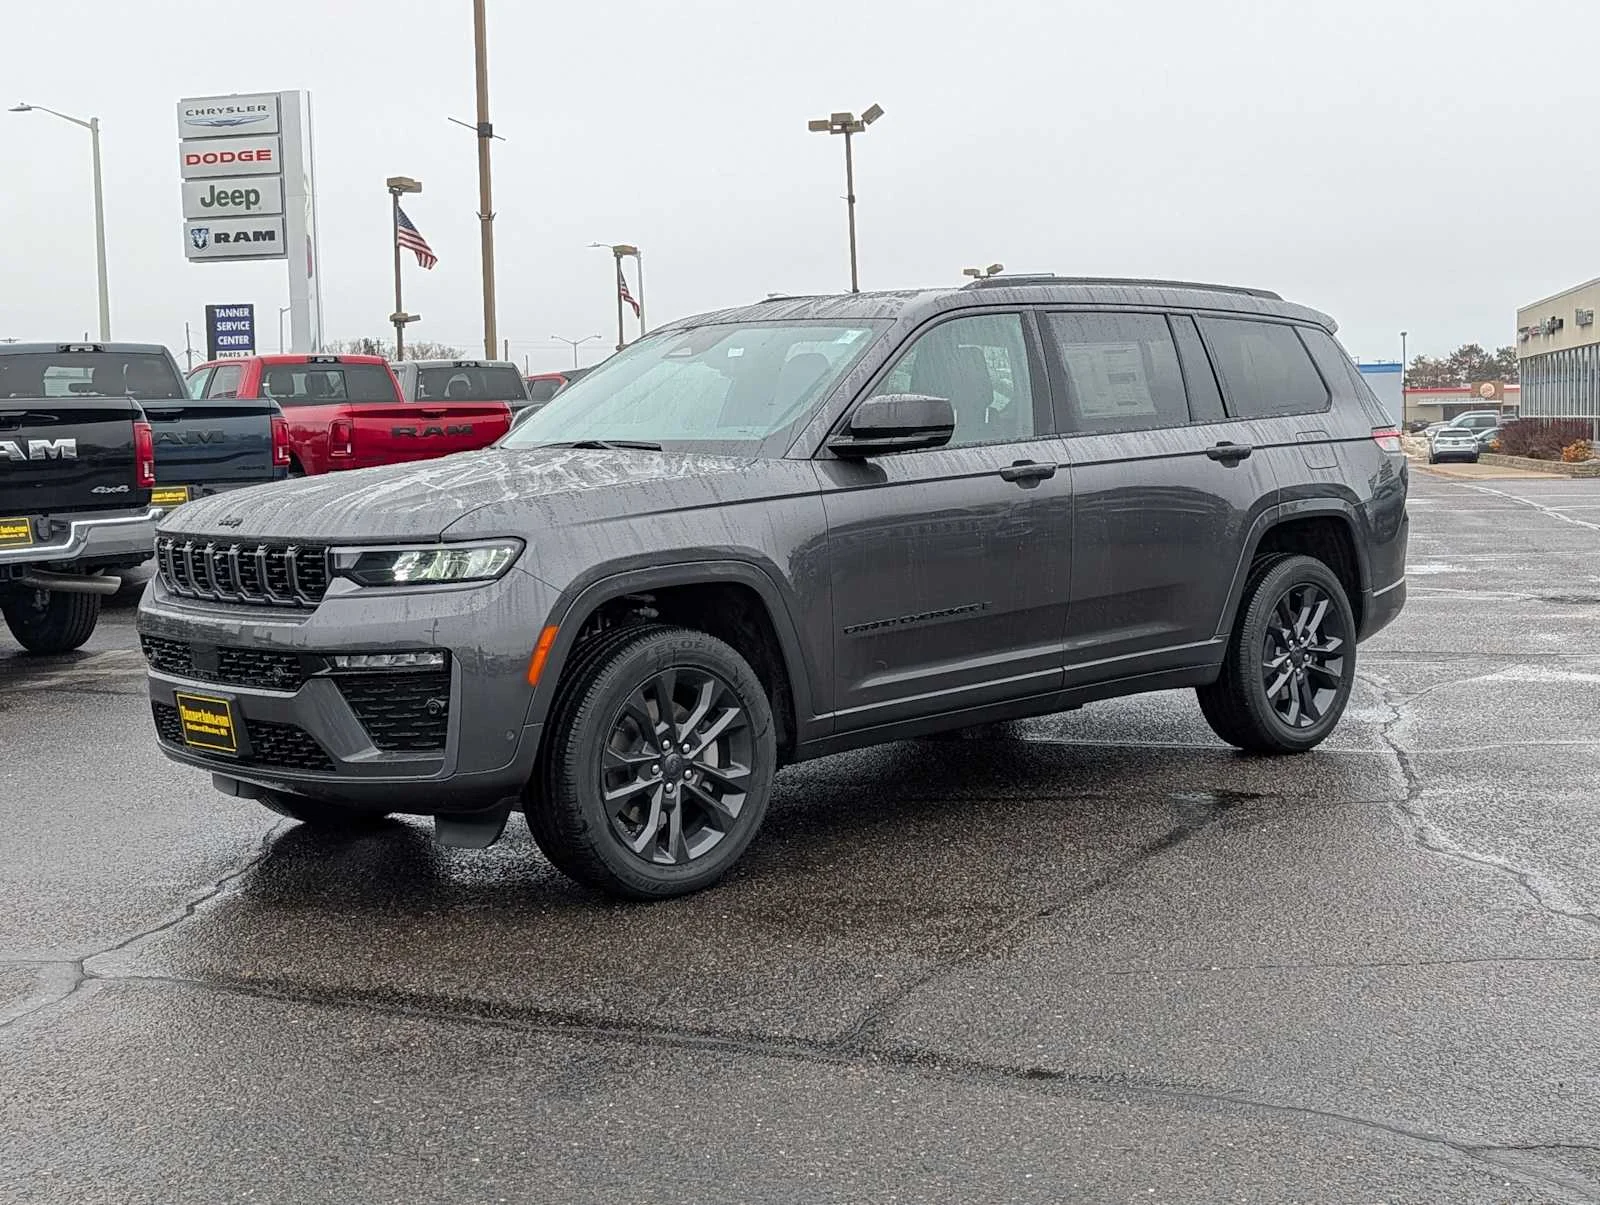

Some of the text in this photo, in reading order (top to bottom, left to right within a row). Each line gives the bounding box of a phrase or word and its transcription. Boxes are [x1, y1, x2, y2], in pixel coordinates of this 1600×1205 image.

[185, 105, 267, 116] CHRYSLER
[186, 149, 272, 166] DODGE
[200, 185, 260, 210] Jeep
[214, 230, 276, 244] RAM
[215, 308, 250, 318] TANNER
[216, 321, 251, 331] SERVICE
[217, 335, 250, 345] CENTER
[392, 425, 473, 438] RAM
